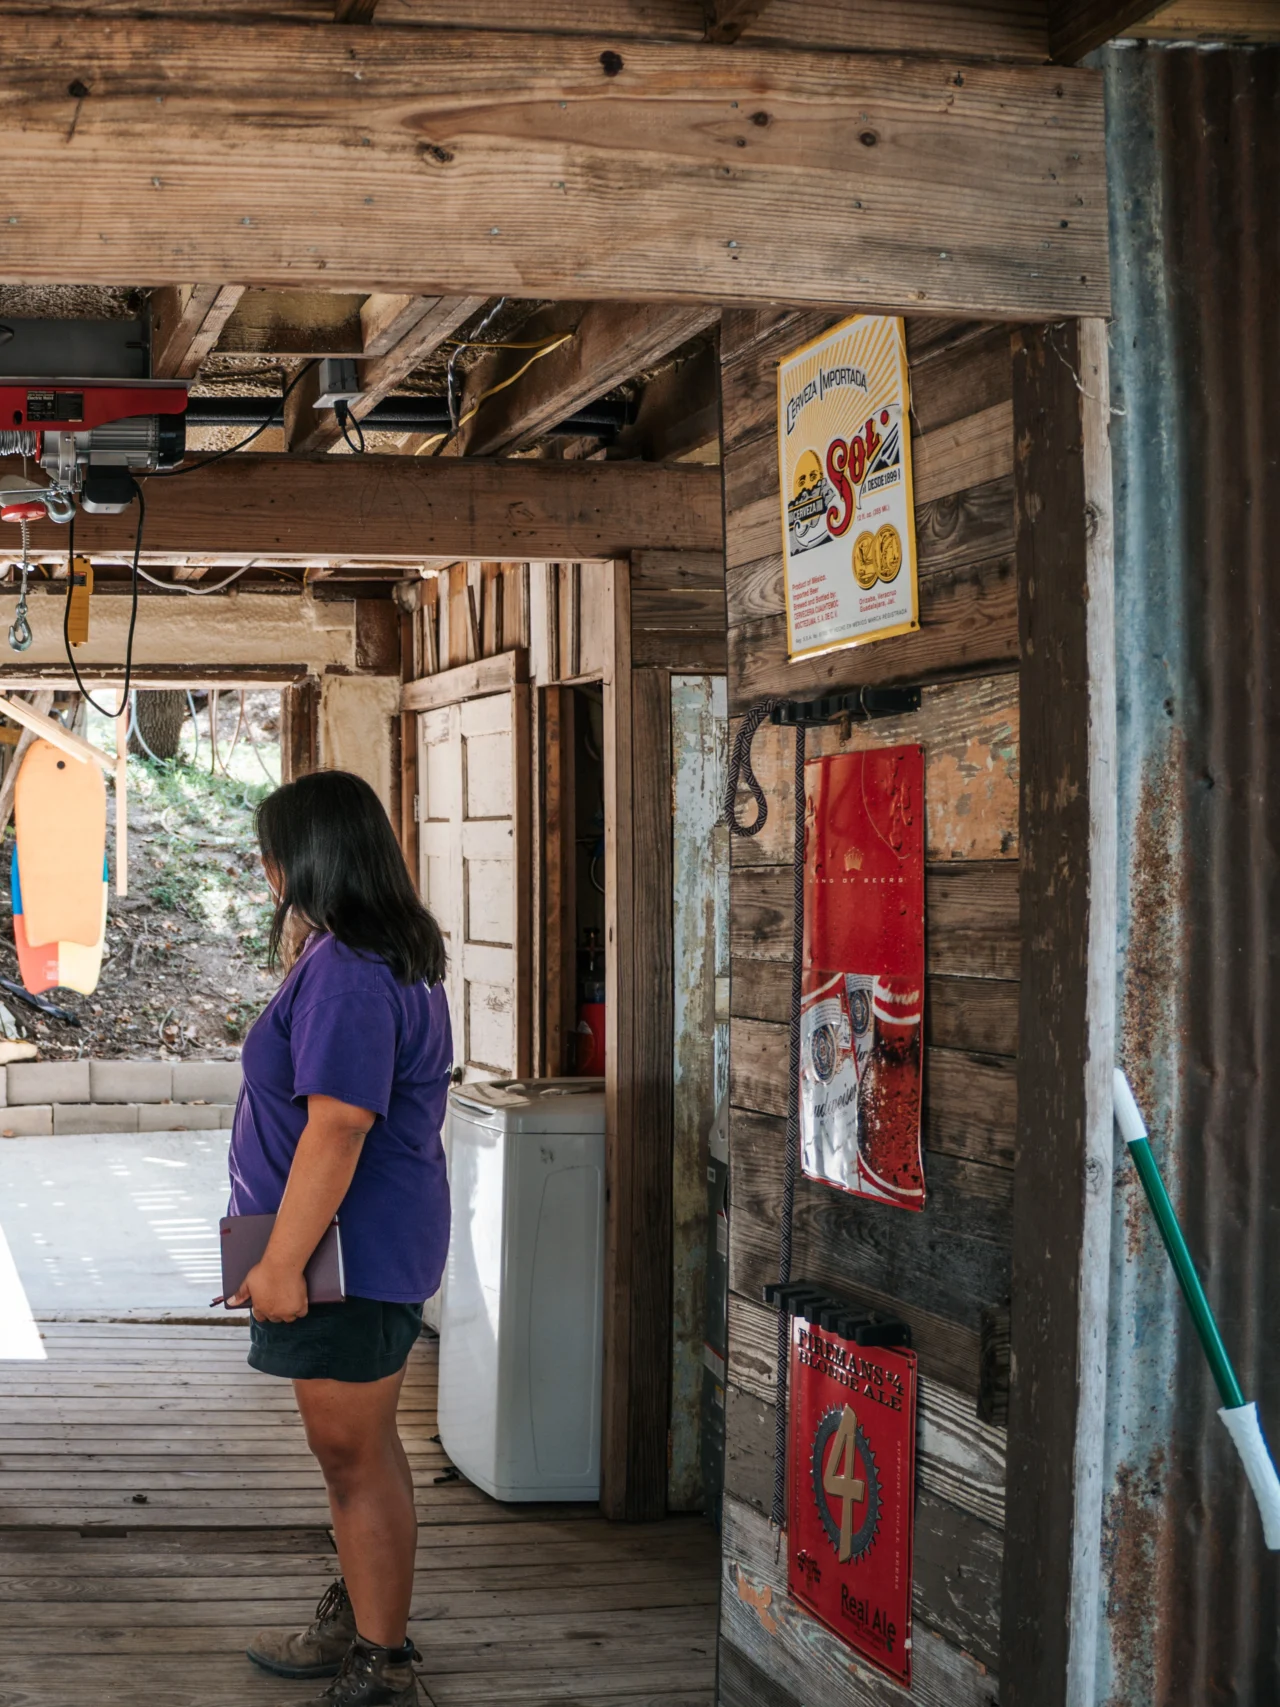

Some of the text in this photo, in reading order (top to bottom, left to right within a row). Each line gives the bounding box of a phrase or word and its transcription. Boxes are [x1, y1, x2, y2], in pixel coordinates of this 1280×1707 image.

[819, 367, 868, 401] IMPORTADA
[793, 501, 817, 521] CERVEZA
[867, 470, 898, 492] DESDE 1899
[798, 1327, 905, 1396] FIREMANS #4
[798, 1347, 903, 1412] BLONDE ALE
[824, 1402, 865, 1564] 4
[841, 1583, 869, 1626] Real
[872, 1607, 897, 1643] Ale
